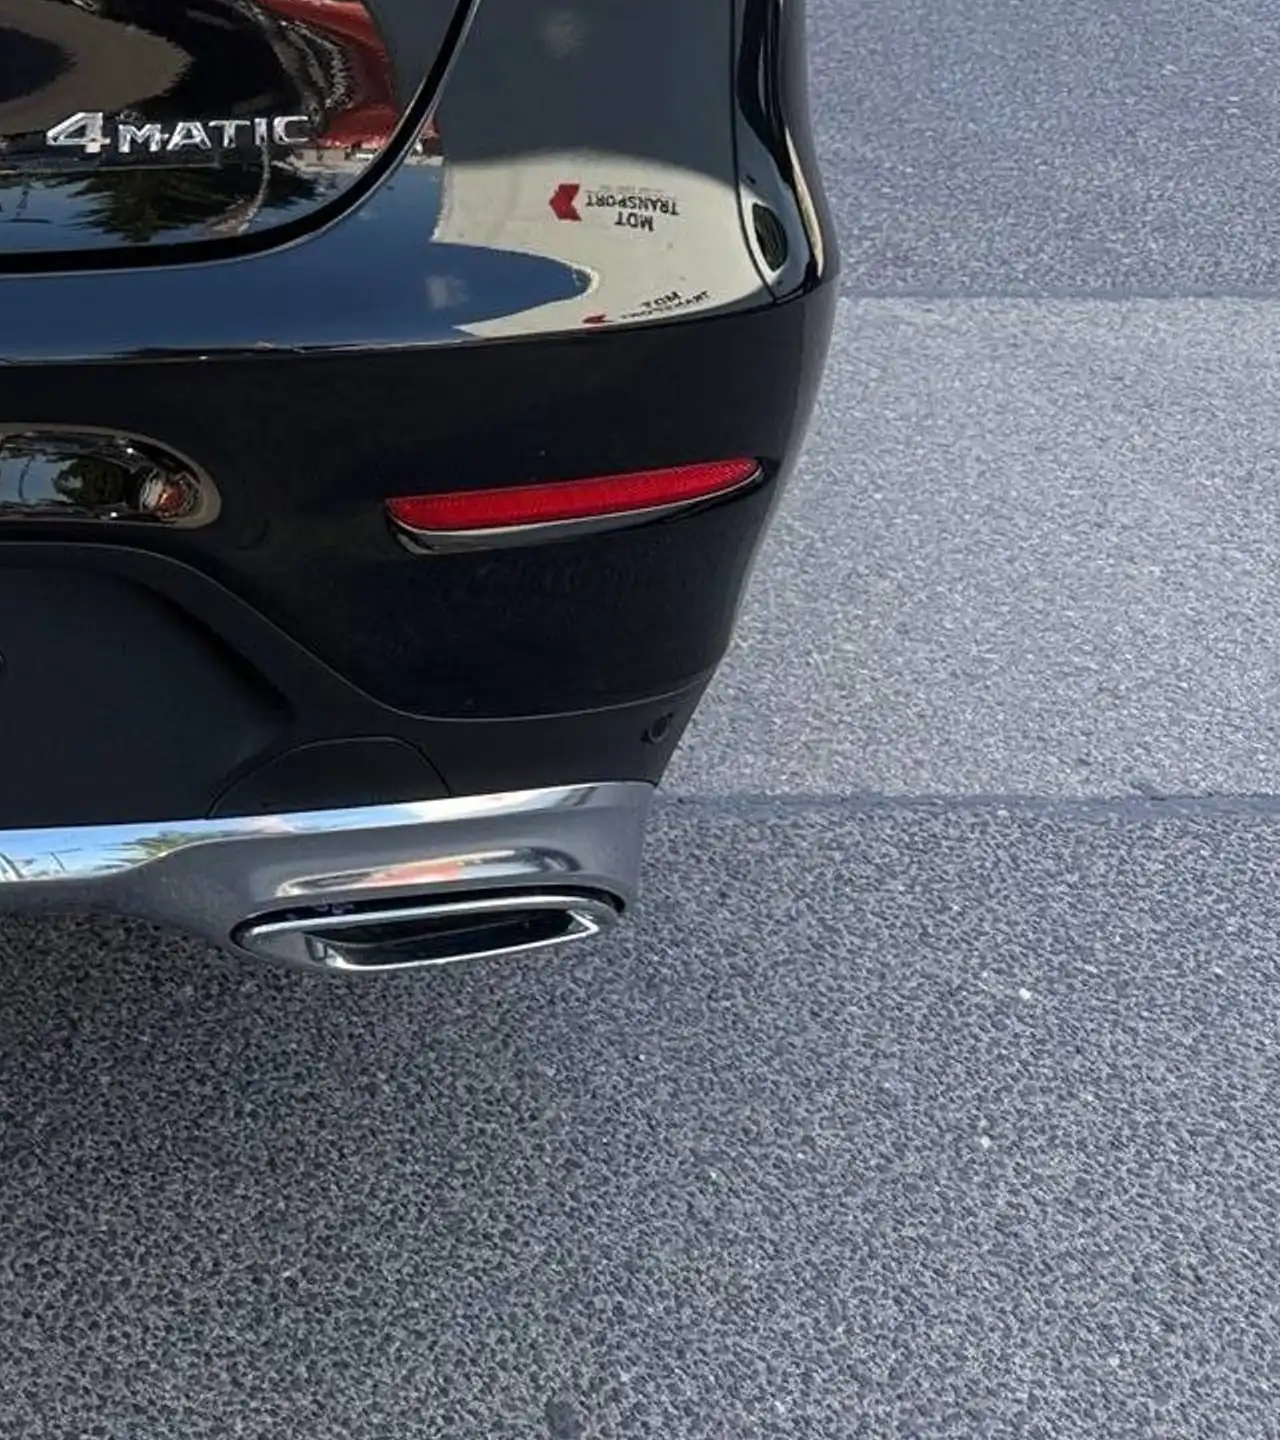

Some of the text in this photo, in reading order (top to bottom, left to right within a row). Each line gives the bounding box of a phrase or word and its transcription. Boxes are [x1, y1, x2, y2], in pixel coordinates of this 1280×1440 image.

[46, 111, 310, 154] 4MATIC
[585, 193, 680, 216] TRANSPORT
[614, 211, 654, 232] MDT
